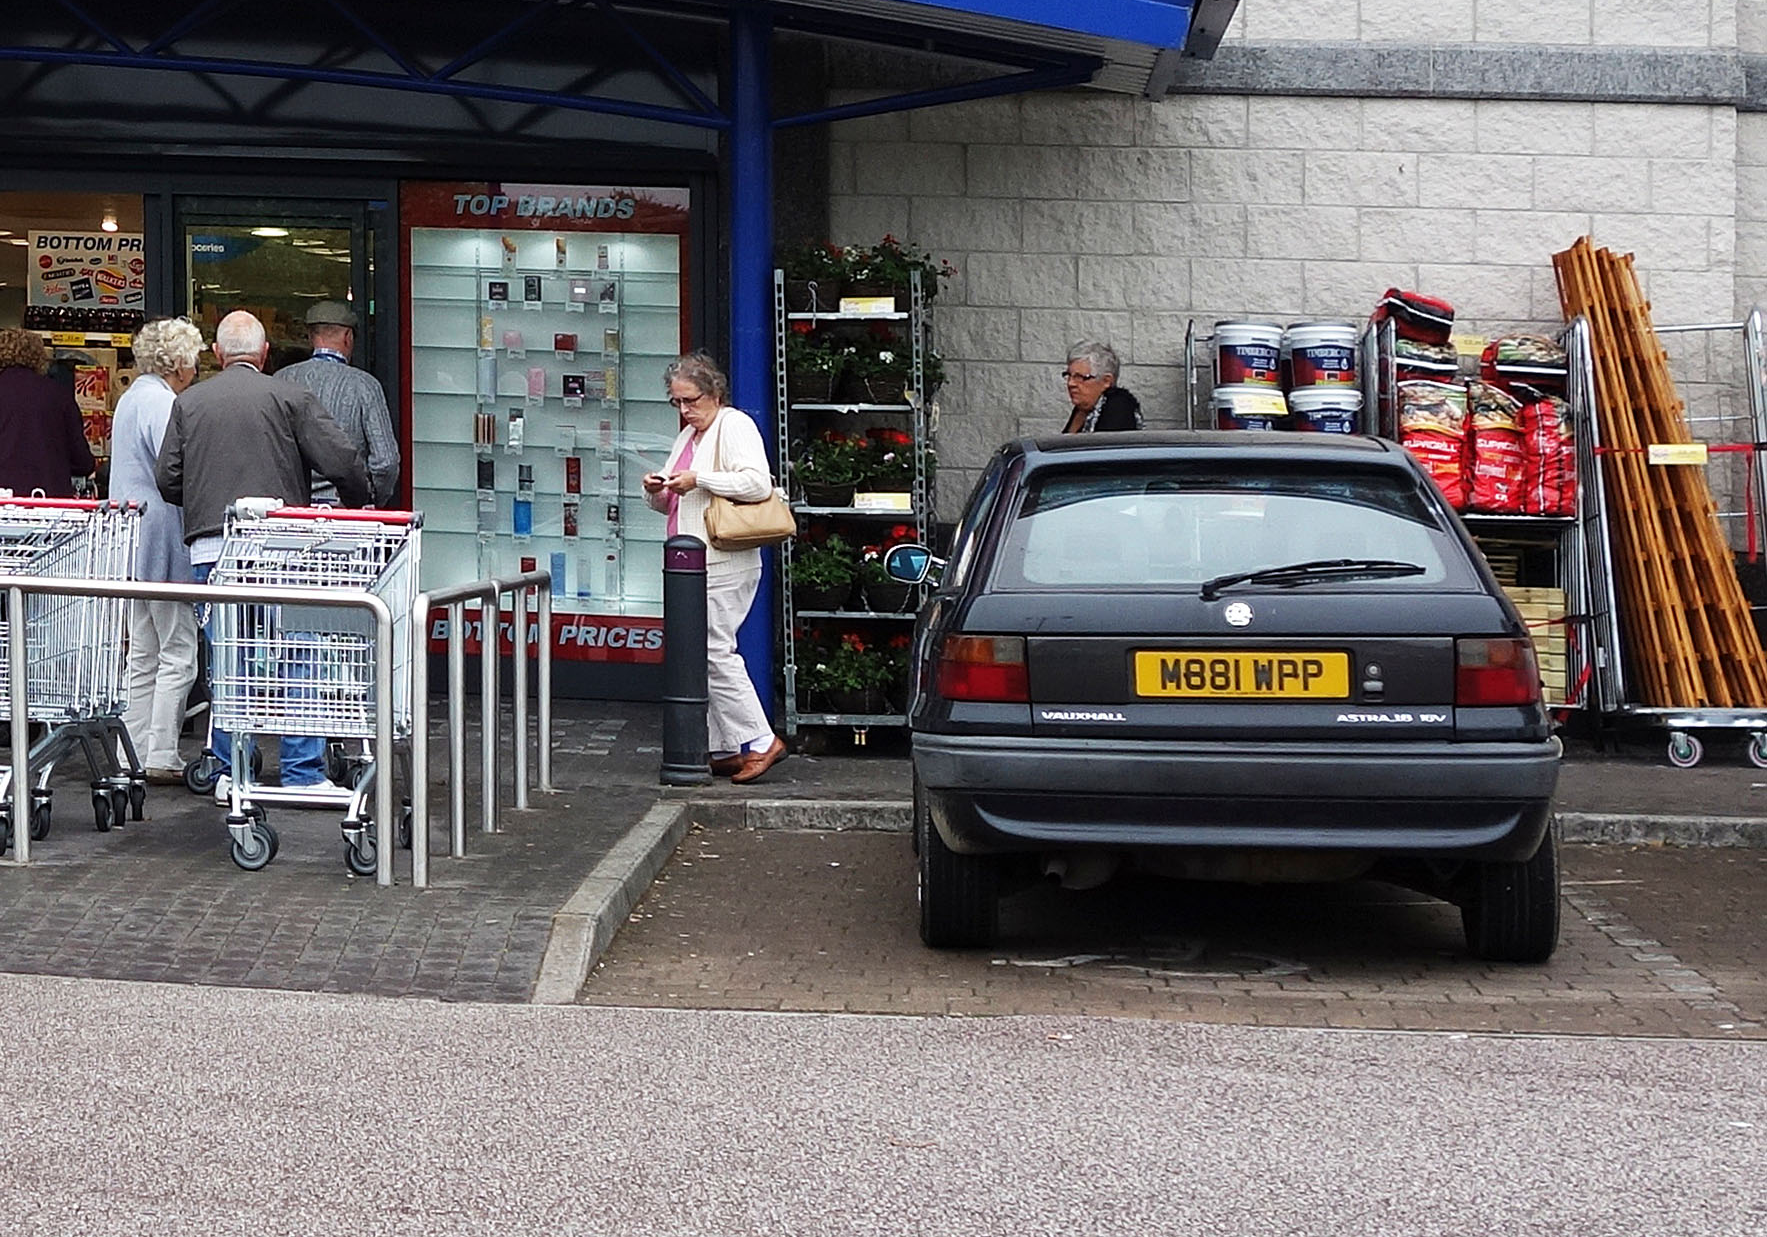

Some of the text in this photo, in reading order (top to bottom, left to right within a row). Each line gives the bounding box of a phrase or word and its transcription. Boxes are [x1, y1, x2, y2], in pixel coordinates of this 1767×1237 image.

[454, 195, 637, 219] TOP BRANDS
[36, 236, 112, 251] BOTTOM
[559, 625, 663, 649] PRICES
[1160, 658, 1323, 692] M881 WPP
[1041, 712, 1127, 721] VAUXHALL
[1337, 714, 1392, 722] ASTRA
